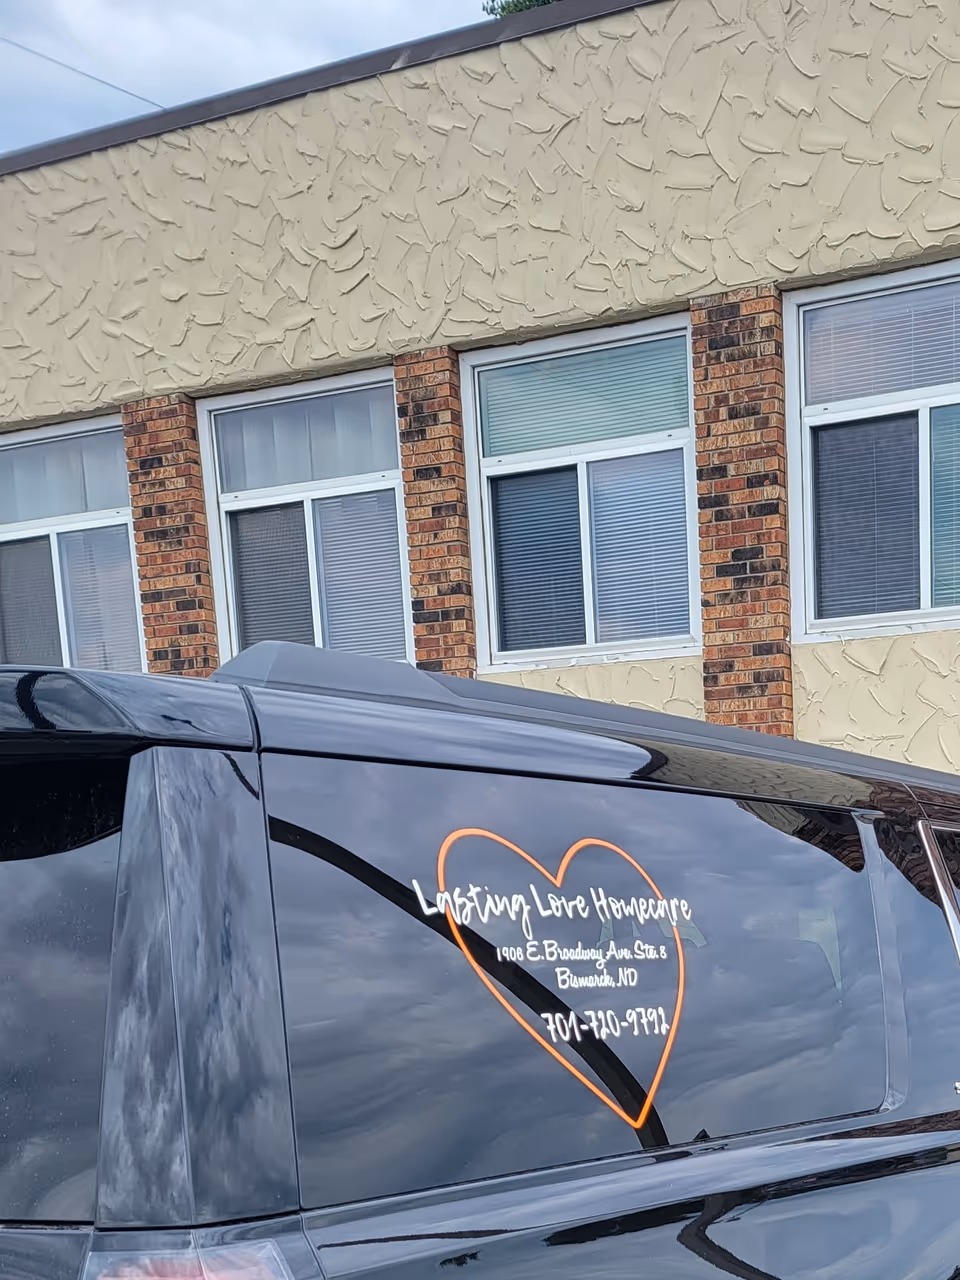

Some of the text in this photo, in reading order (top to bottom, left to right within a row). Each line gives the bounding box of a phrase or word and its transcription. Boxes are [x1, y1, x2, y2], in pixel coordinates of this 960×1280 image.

[411, 878, 692, 940] Lasting Love Homecare
[542, 939, 607, 970] Broadway
[605, 940, 633, 961] Ave.
[659, 945, 668, 959] 8
[616, 966, 638, 987] ND
[540, 1006, 671, 1043] 701-720-9792
